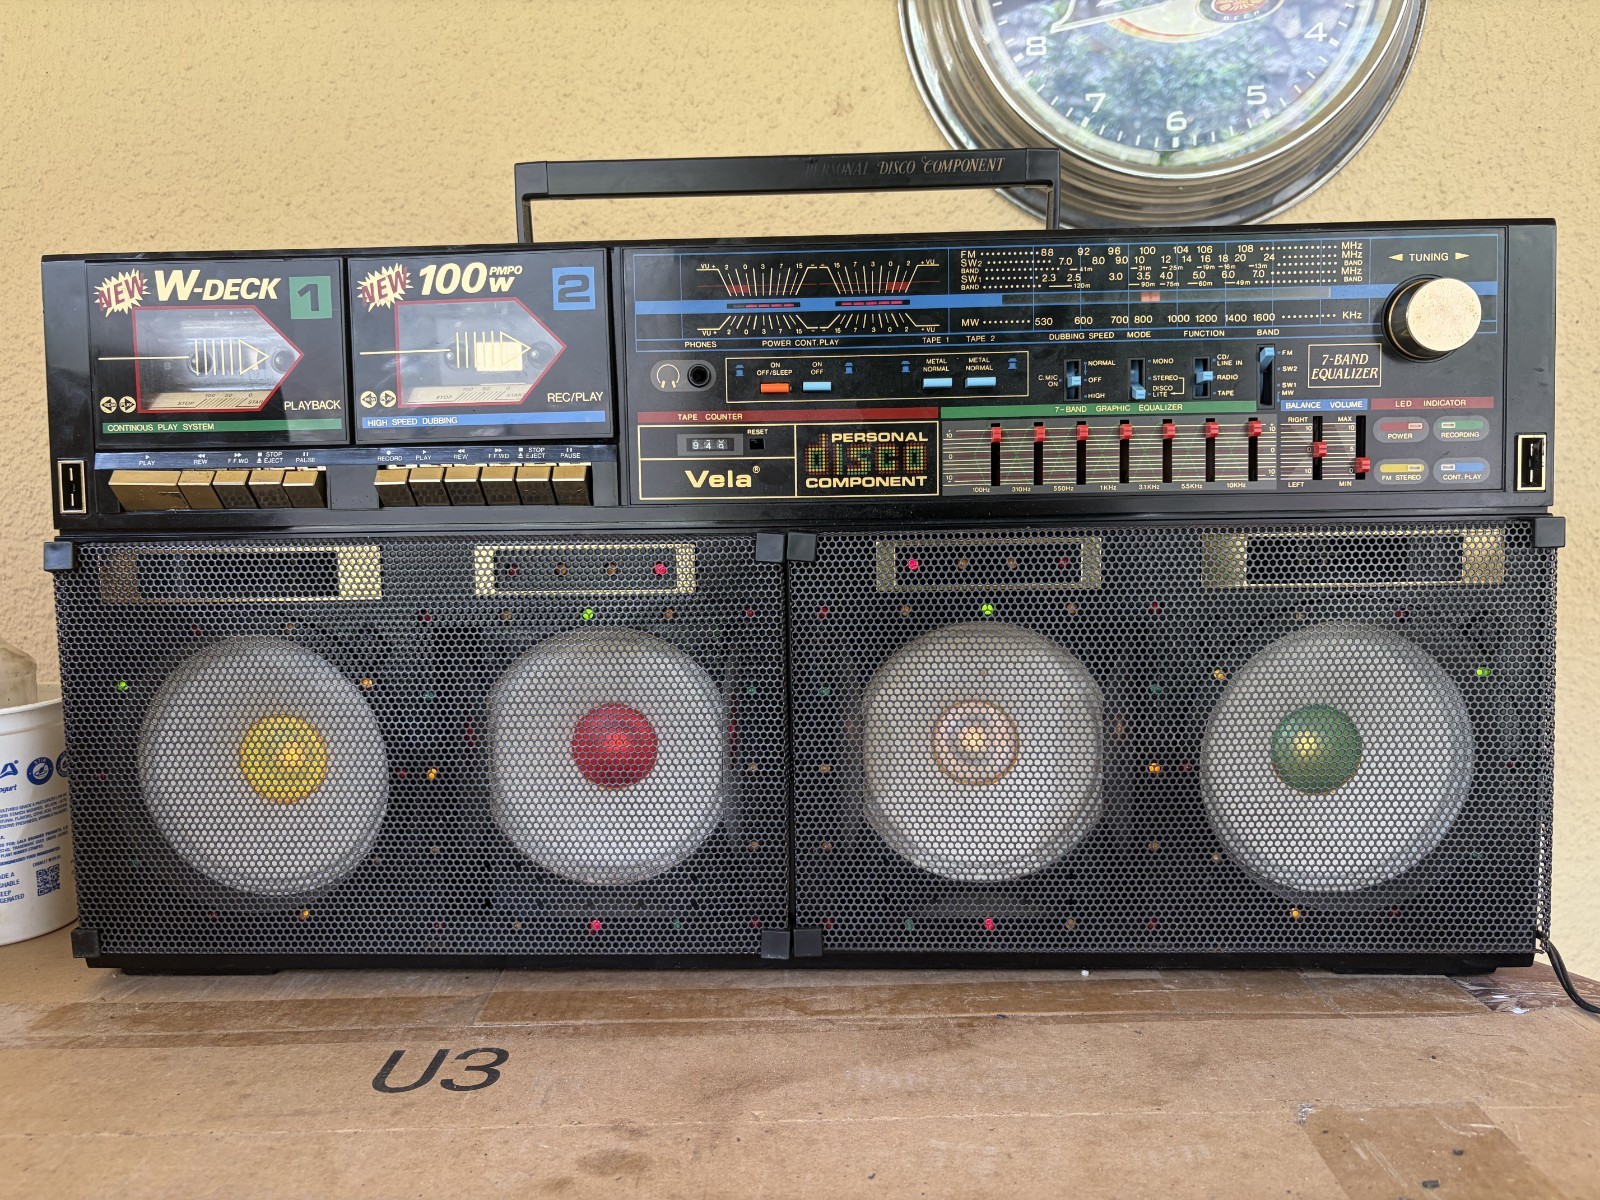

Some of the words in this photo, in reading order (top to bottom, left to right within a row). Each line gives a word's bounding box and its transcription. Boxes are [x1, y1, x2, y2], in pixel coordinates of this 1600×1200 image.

[1305, 23, 1327, 40] 4
[1026, 37, 1048, 56] 8
[1085, 93, 1106, 111] 7
[1246, 86, 1267, 104] 5
[1166, 111, 1187, 131] 6
[877, 160, 915, 175] DISCO
[921, 156, 1005, 173] COMPONENT
[1108, 247, 1121, 255] 96
[1238, 245, 1253, 253] 108
[1341, 242, 1363, 250] MHz
[961, 259, 982, 267] SW2
[1092, 257, 1105, 265] 8.0
[1115, 256, 1128, 264] 9.0
[1134, 256, 1145, 264] 10
[1182, 255, 1192, 263] 14
[1218, 254, 1228, 262] 18
[1235, 254, 1246, 262] 20
[1264, 253, 1275, 261] 24
[1342, 251, 1363, 259] MHz
[1409, 253, 1448, 261] TUNING
[489, 265, 523, 275] PMPO
[1042, 274, 1056, 282] 2.3
[1137, 272, 1151, 280] 3.5
[1192, 271, 1205, 279] 5.0
[1253, 270, 1264, 278] 7.0
[1341, 267, 1362, 275] MHz
[155, 270, 281, 301] W-DECK
[361, 267, 408, 306] NEW
[419, 262, 487, 295] 100
[489, 277, 515, 292] W
[99, 273, 144, 312] NEW
[557, 274, 590, 303] 2
[297, 283, 320, 312] 1
[1111, 316, 1129, 324] 700
[1167, 315, 1190, 323] 1000
[1196, 315, 1217, 323] 1200
[1225, 314, 1247, 322] 1400
[1252, 313, 1275, 321] 1600
[1342, 311, 1362, 319] KHz
[1049, 333, 1085, 341] DUBBING
[1322, 354, 1369, 365] 7-BAND
[1311, 368, 1378, 381] EQUALIZER
[284, 400, 341, 411] PLAYBACK
[547, 392, 604, 403] REC/PLAY
[832, 432, 928, 442] PERSONAL
[685, 470, 751, 488] Vela
[806, 476, 927, 488] COMPONENT
[372, 1048, 509, 1093] U3
